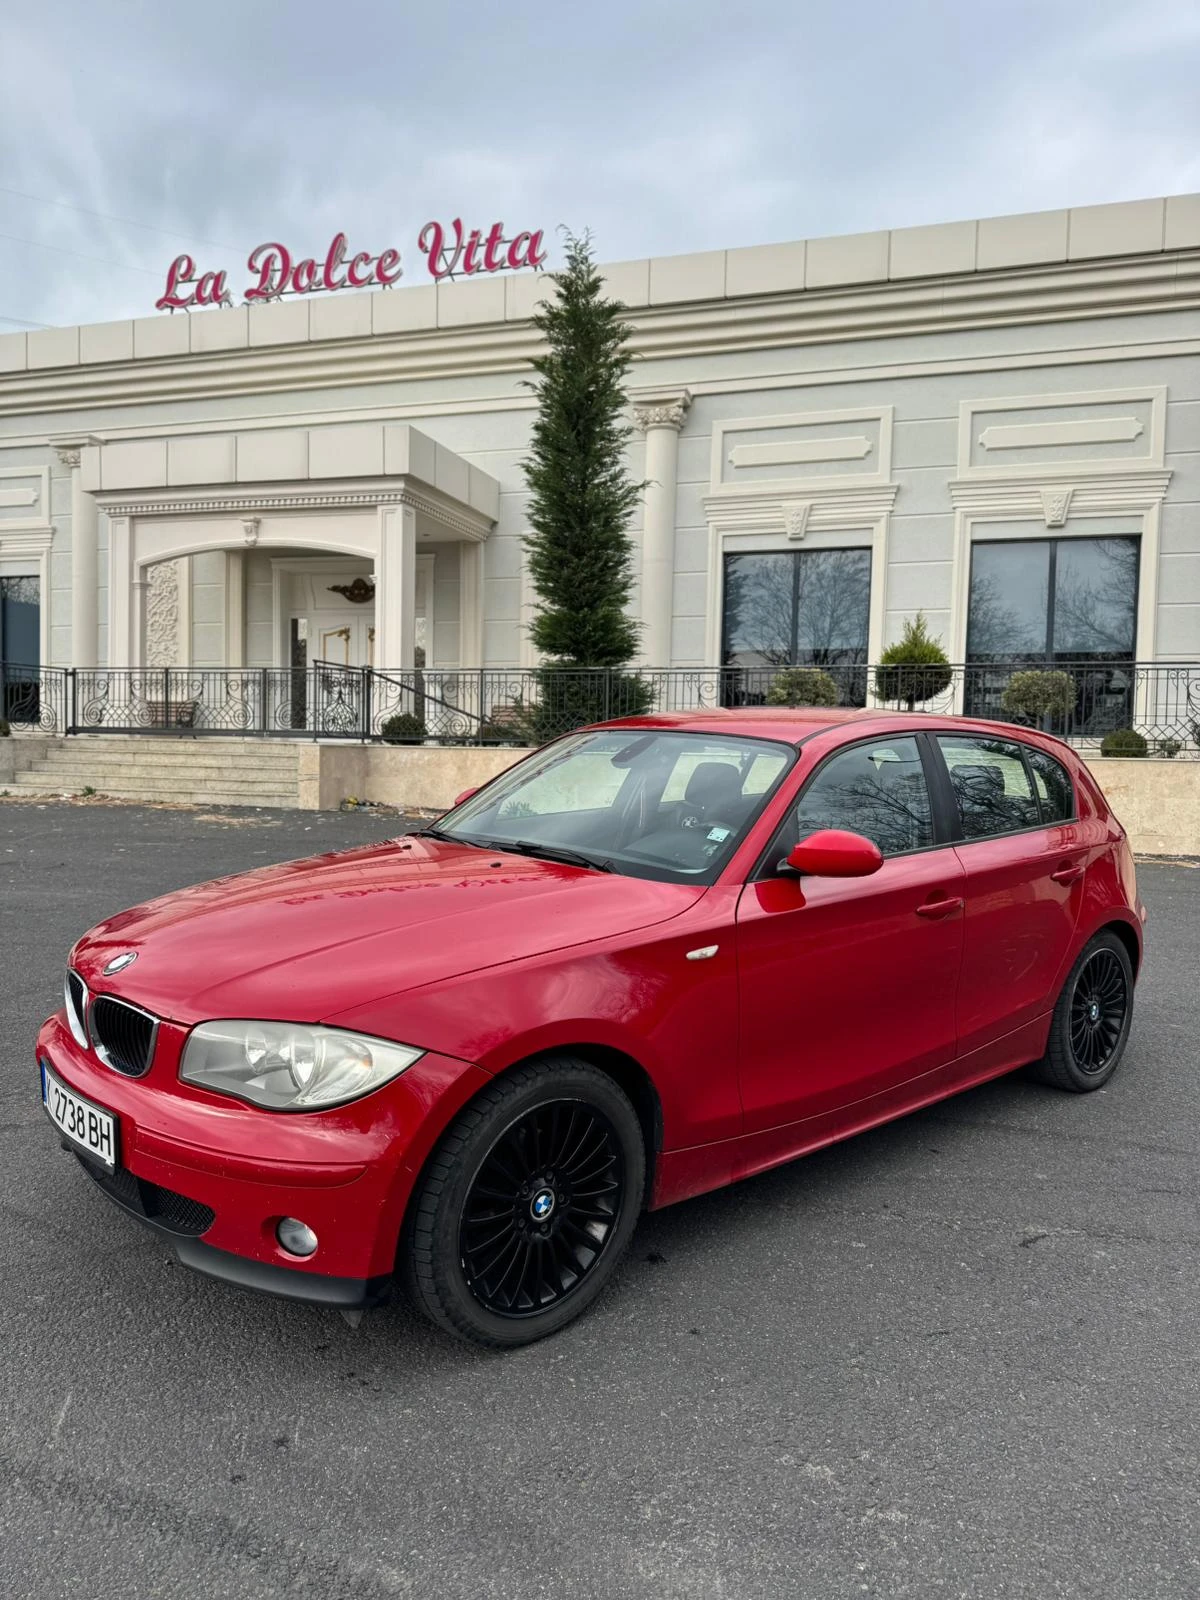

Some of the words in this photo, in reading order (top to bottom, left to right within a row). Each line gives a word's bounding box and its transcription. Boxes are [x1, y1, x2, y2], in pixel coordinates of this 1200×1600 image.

[155, 254, 228, 309] La
[244, 232, 402, 299] Dolce
[418, 217, 547, 278] Vita
[55, 1087, 86, 1139] 2738
[88, 1111, 112, 1156] BH
